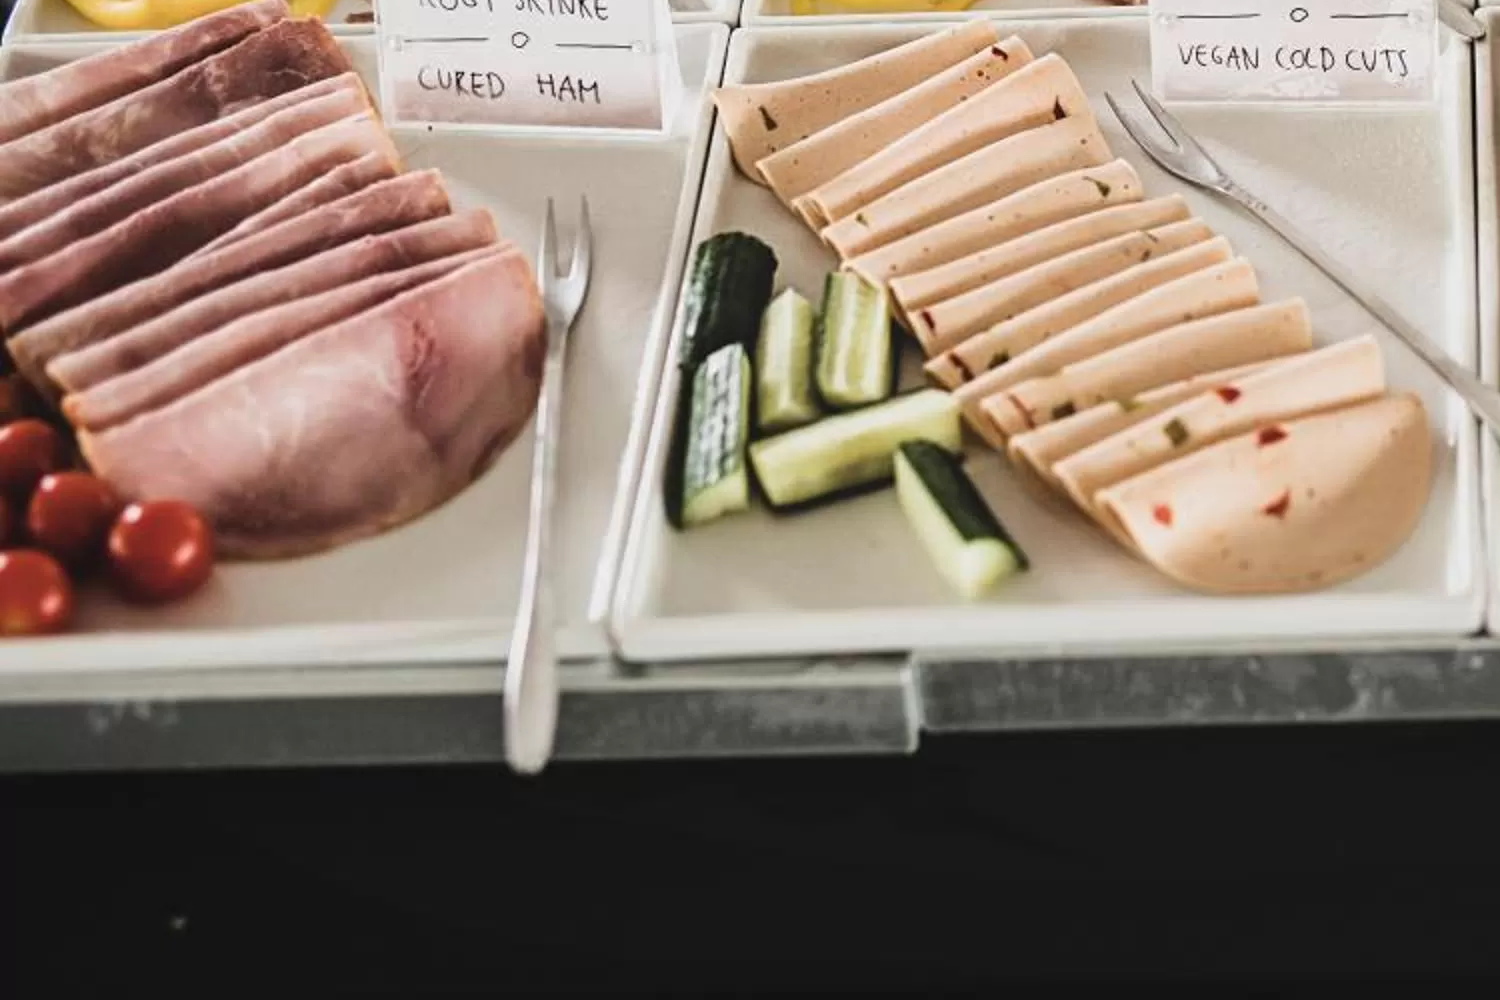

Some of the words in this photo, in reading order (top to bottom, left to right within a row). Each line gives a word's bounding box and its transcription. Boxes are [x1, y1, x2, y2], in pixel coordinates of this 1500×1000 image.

[1178, 42, 1260, 71] VEGAN
[1275, 45, 1336, 73] COLD
[1344, 47, 1409, 78] CUTS
[417, 66, 506, 100] CURED
[536, 72, 602, 104] HAM
